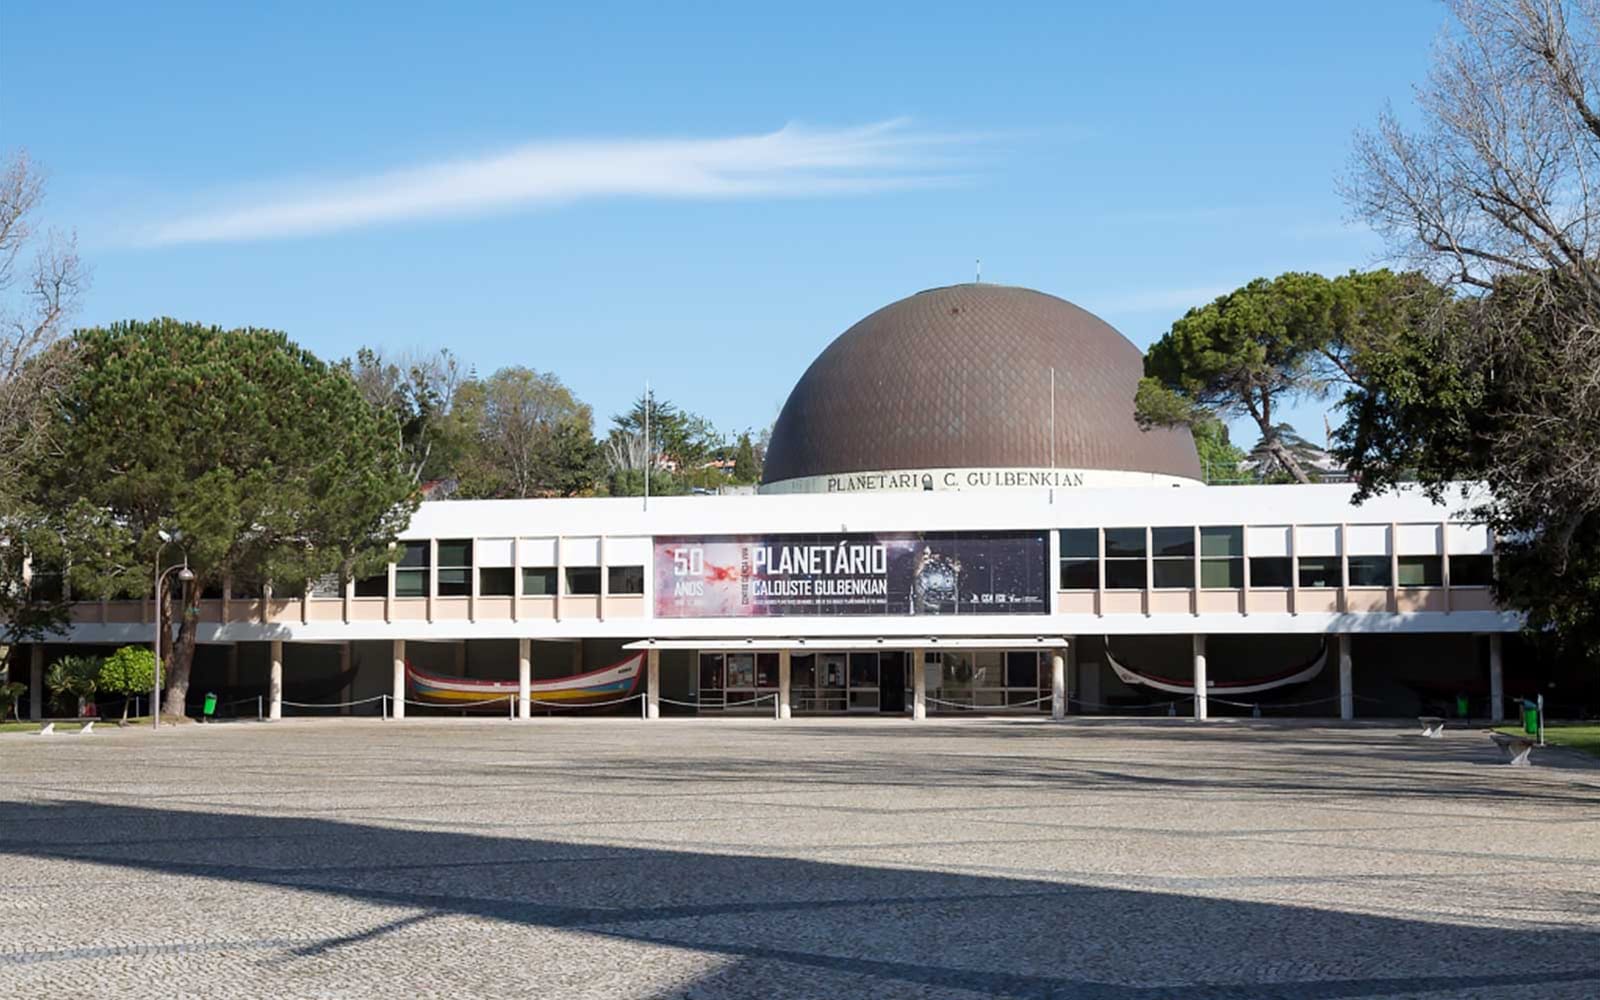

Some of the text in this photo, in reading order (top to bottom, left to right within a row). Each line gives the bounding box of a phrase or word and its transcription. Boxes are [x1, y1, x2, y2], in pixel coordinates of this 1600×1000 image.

[944, 473, 958, 486] C.
[967, 472, 1083, 487] GULBENKIAN
[674, 548, 704, 576] 50
[752, 541, 887, 575] PLANETÁRIO
[674, 582, 704, 596] ANOS
[752, 579, 887, 596] CALOUSTE GULBENKIAN
